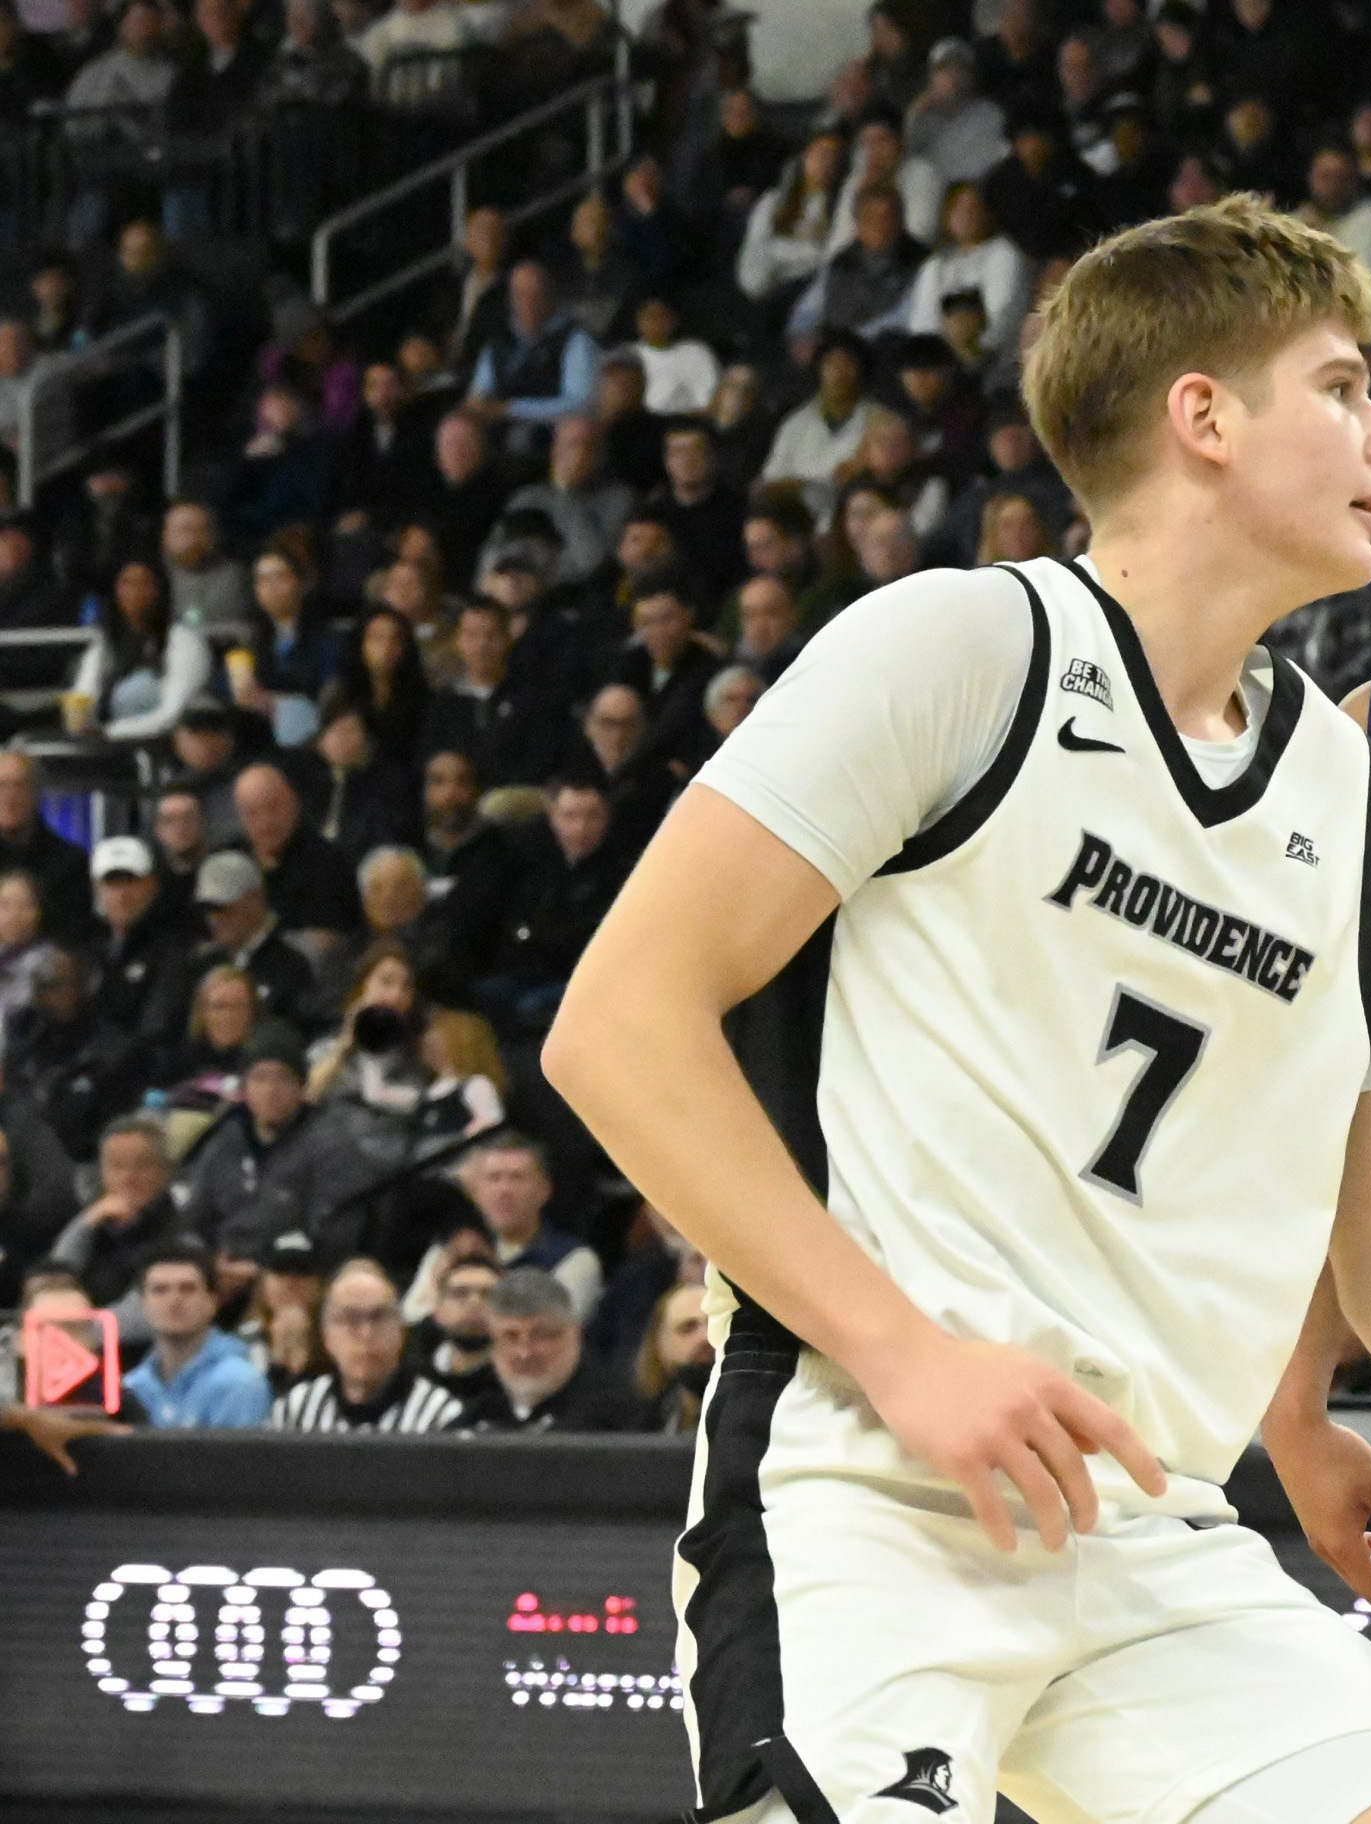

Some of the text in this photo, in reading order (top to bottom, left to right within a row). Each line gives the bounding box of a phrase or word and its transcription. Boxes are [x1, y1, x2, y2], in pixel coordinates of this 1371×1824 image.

[1070, 659, 1094, 679] BE
[1061, 673, 1114, 711] CHANG
[1286, 843, 1320, 867] EAST
[1289, 831, 1314, 852] BIG
[1042, 827, 1318, 1007] PROVIDENCE
[1079, 981, 1212, 1208] 7
